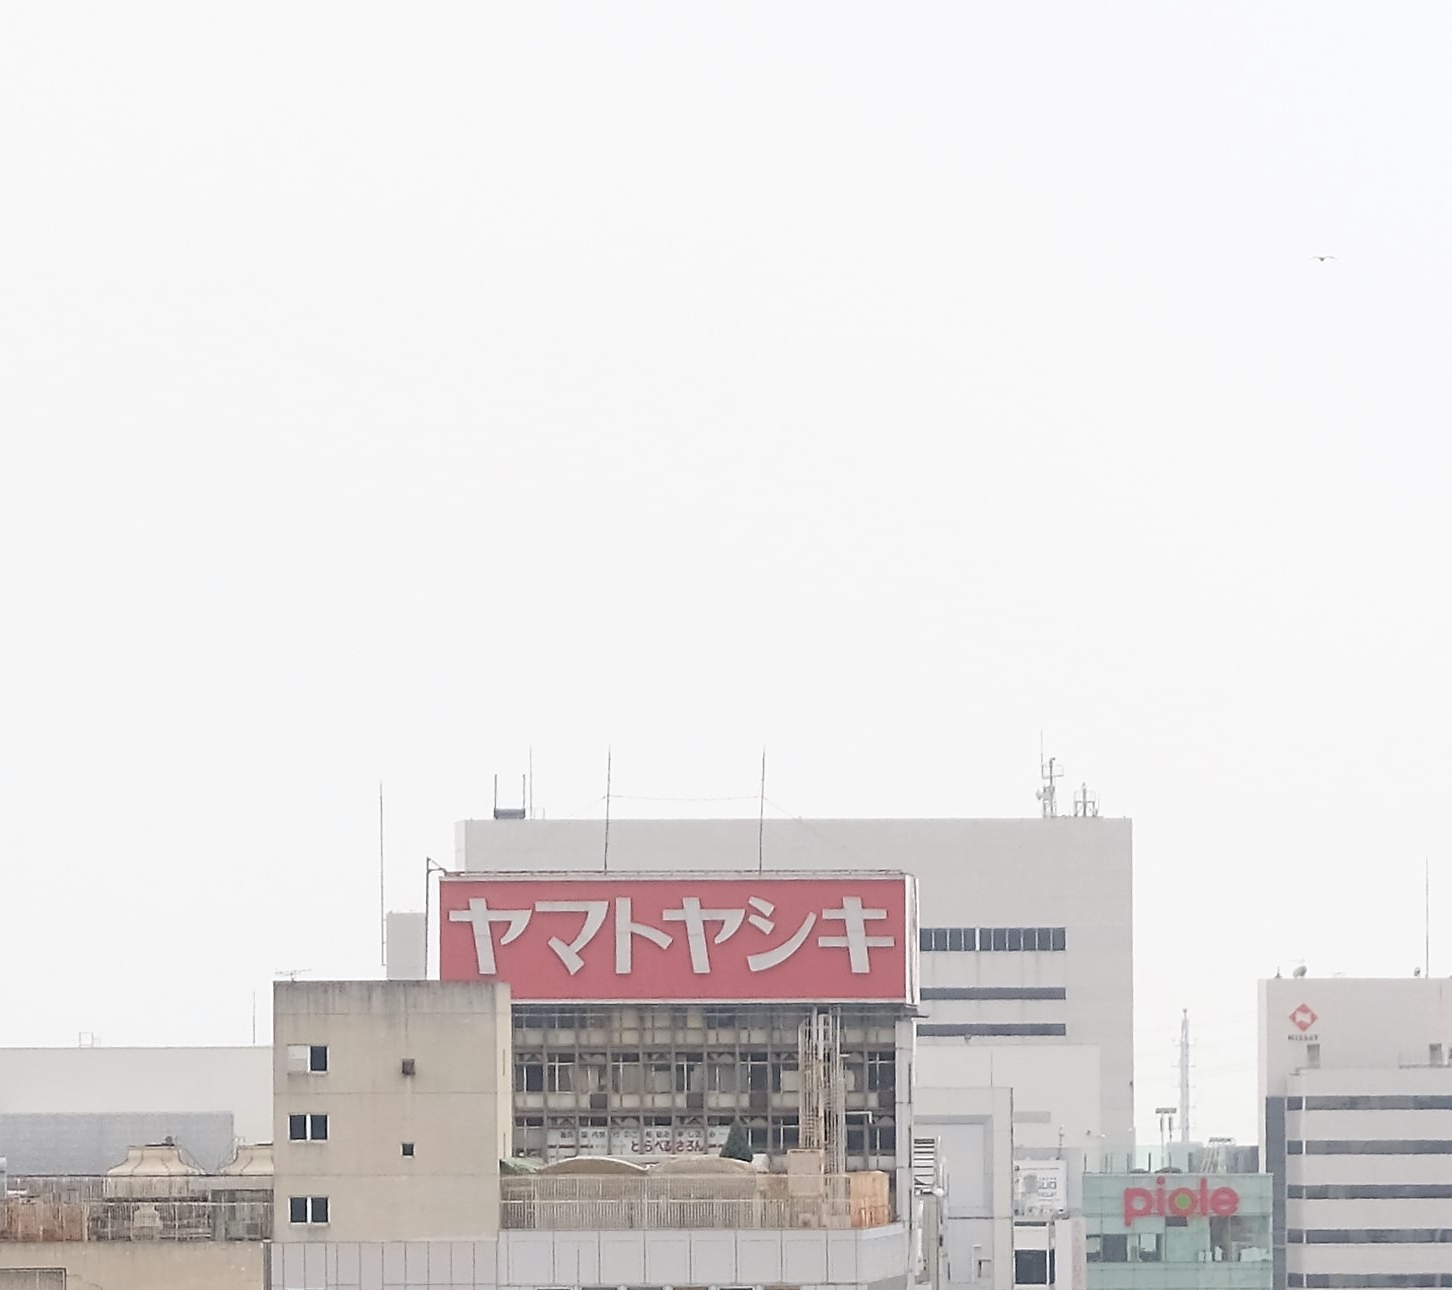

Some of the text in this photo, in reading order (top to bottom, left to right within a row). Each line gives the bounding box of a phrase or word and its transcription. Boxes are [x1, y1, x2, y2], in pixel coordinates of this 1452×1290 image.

[448, 896, 896, 976] ヤマトヤシキ
[1124, 1175, 1239, 1227] piole
